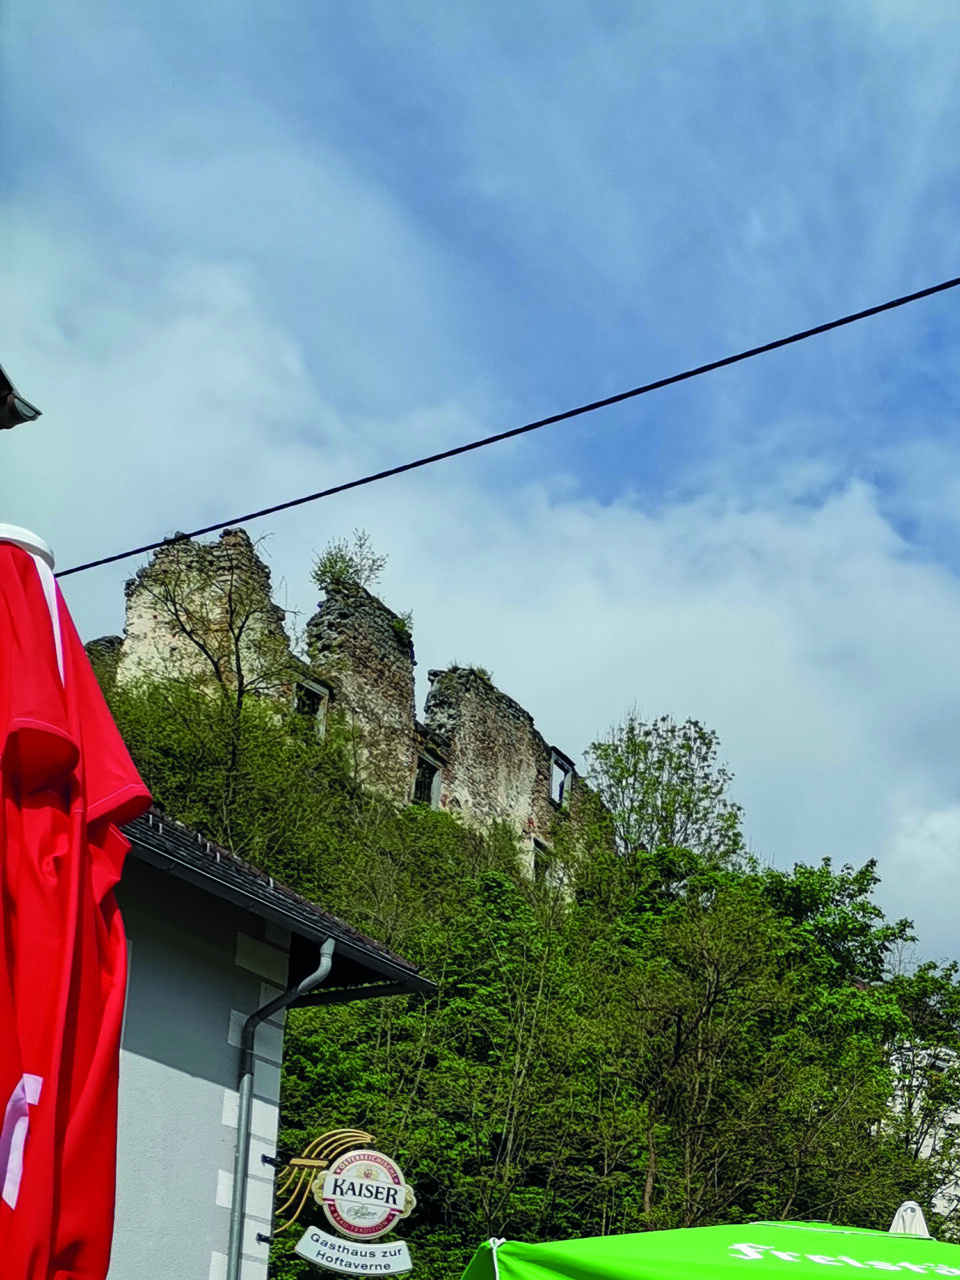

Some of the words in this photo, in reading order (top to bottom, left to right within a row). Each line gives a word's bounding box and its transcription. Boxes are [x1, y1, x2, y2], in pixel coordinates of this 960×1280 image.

[332, 1178, 398, 1205] KAISER
[310, 1233, 377, 1258] Gasthaus
[381, 1248, 402, 1258] zur
[315, 1249, 391, 1271] Hoftaverne
